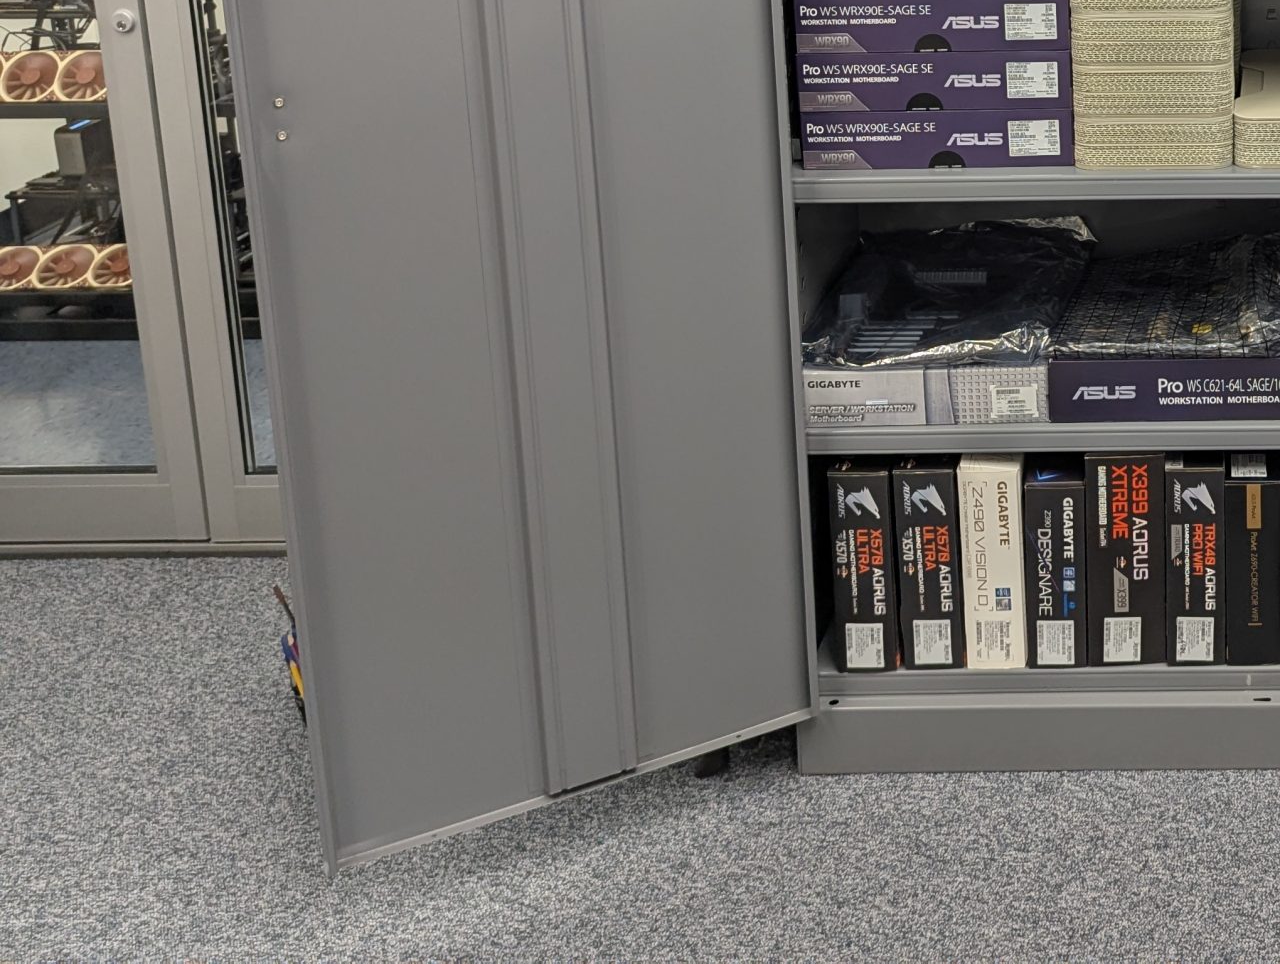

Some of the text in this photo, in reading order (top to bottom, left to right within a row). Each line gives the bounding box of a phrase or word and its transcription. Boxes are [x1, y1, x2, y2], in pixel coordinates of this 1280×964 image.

[800, 5, 932, 17] Pro WS WRX90E-SAGE SE
[801, 17, 897, 26] WORKSTATION MOTHERBOARD
[941, 15, 1000, 29] ASUS
[814, 36, 850, 46] WRX90
[802, 63, 934, 75] Pro WS WRX90E-SAGE SE
[944, 74, 1001, 88] ASUS
[817, 94, 852, 104] WRX90
[806, 122, 937, 135] Pro WS WRX90E-SAGE SE
[946, 133, 1004, 146] ASUS
[821, 153, 855, 163] WRX90
[807, 380, 861, 389] GIGABYTE
[1072, 386, 1136, 401] ASUS
[1158, 378, 1184, 394] Pro
[1186, 379, 1201, 392] WS
[1203, 378, 1244, 392] C621-64L
[809, 404, 914, 414] SERVER WORKSTATION
[1159, 396, 1223, 405] WORKSTATION
[809, 414, 863, 423] Motherboard
[837, 483, 846, 519] AORUS
[902, 480, 912, 516] AORUS
[1097, 466, 1107, 525] GAMING MOTHERBOARD
[1111, 465, 1129, 540] XTREME
[997, 481, 1010, 546] GIGABYTE
[1131, 464, 1149, 580] X399 AORUS
[1063, 497, 1074, 559] GIGABYTE
[835, 538, 848, 564] X570
[856, 529, 870, 574] ULTRA
[902, 537, 914, 561] X570
[922, 526, 937, 571] ULTRA
[972, 487, 989, 607] Z490 VISION D
[1192, 523, 1204, 576] PRO WIFI
[850, 552, 858, 597] MOTHERBOARD
[870, 528, 887, 616] X570 AORUS
[916, 548, 925, 594] MOTHERBOARD
[936, 525, 954, 612] X570 AORUS
[1037, 528, 1053, 616] DESIGNARE
[1205, 523, 1217, 611] TRX40 AORUS
[1250, 531, 1259, 622] ProArt Z690-CREATOR WIFI
[1116, 588, 1127, 608] X399
